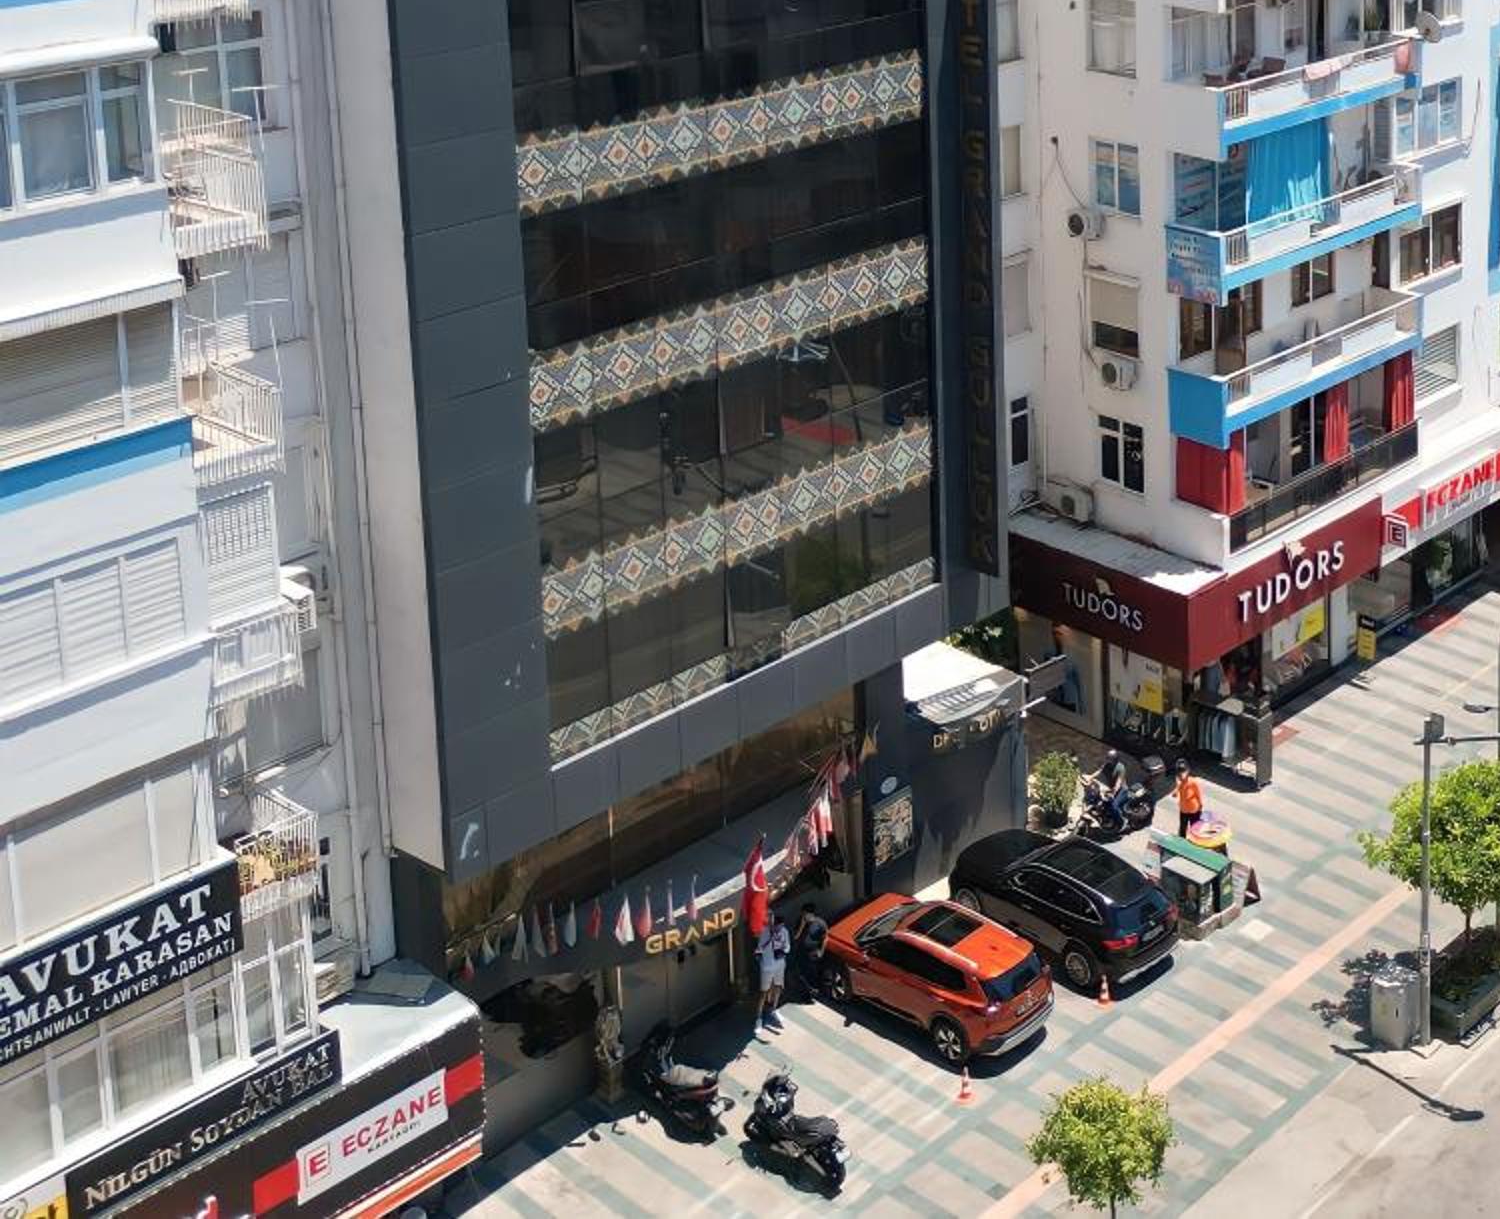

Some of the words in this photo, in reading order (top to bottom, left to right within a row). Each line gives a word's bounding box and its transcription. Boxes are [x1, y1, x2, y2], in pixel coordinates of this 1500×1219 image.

[1062, 582, 1143, 632] TUDORS
[1238, 541, 1344, 623] TUDORS
[0, 884, 211, 1008] AVUKAT
[91, 911, 233, 996] KARASAN
[646, 908, 735, 954] GRAND
[103, 975, 158, 1010] LAWYER
[341, 1086, 441, 1157] ECZANE
